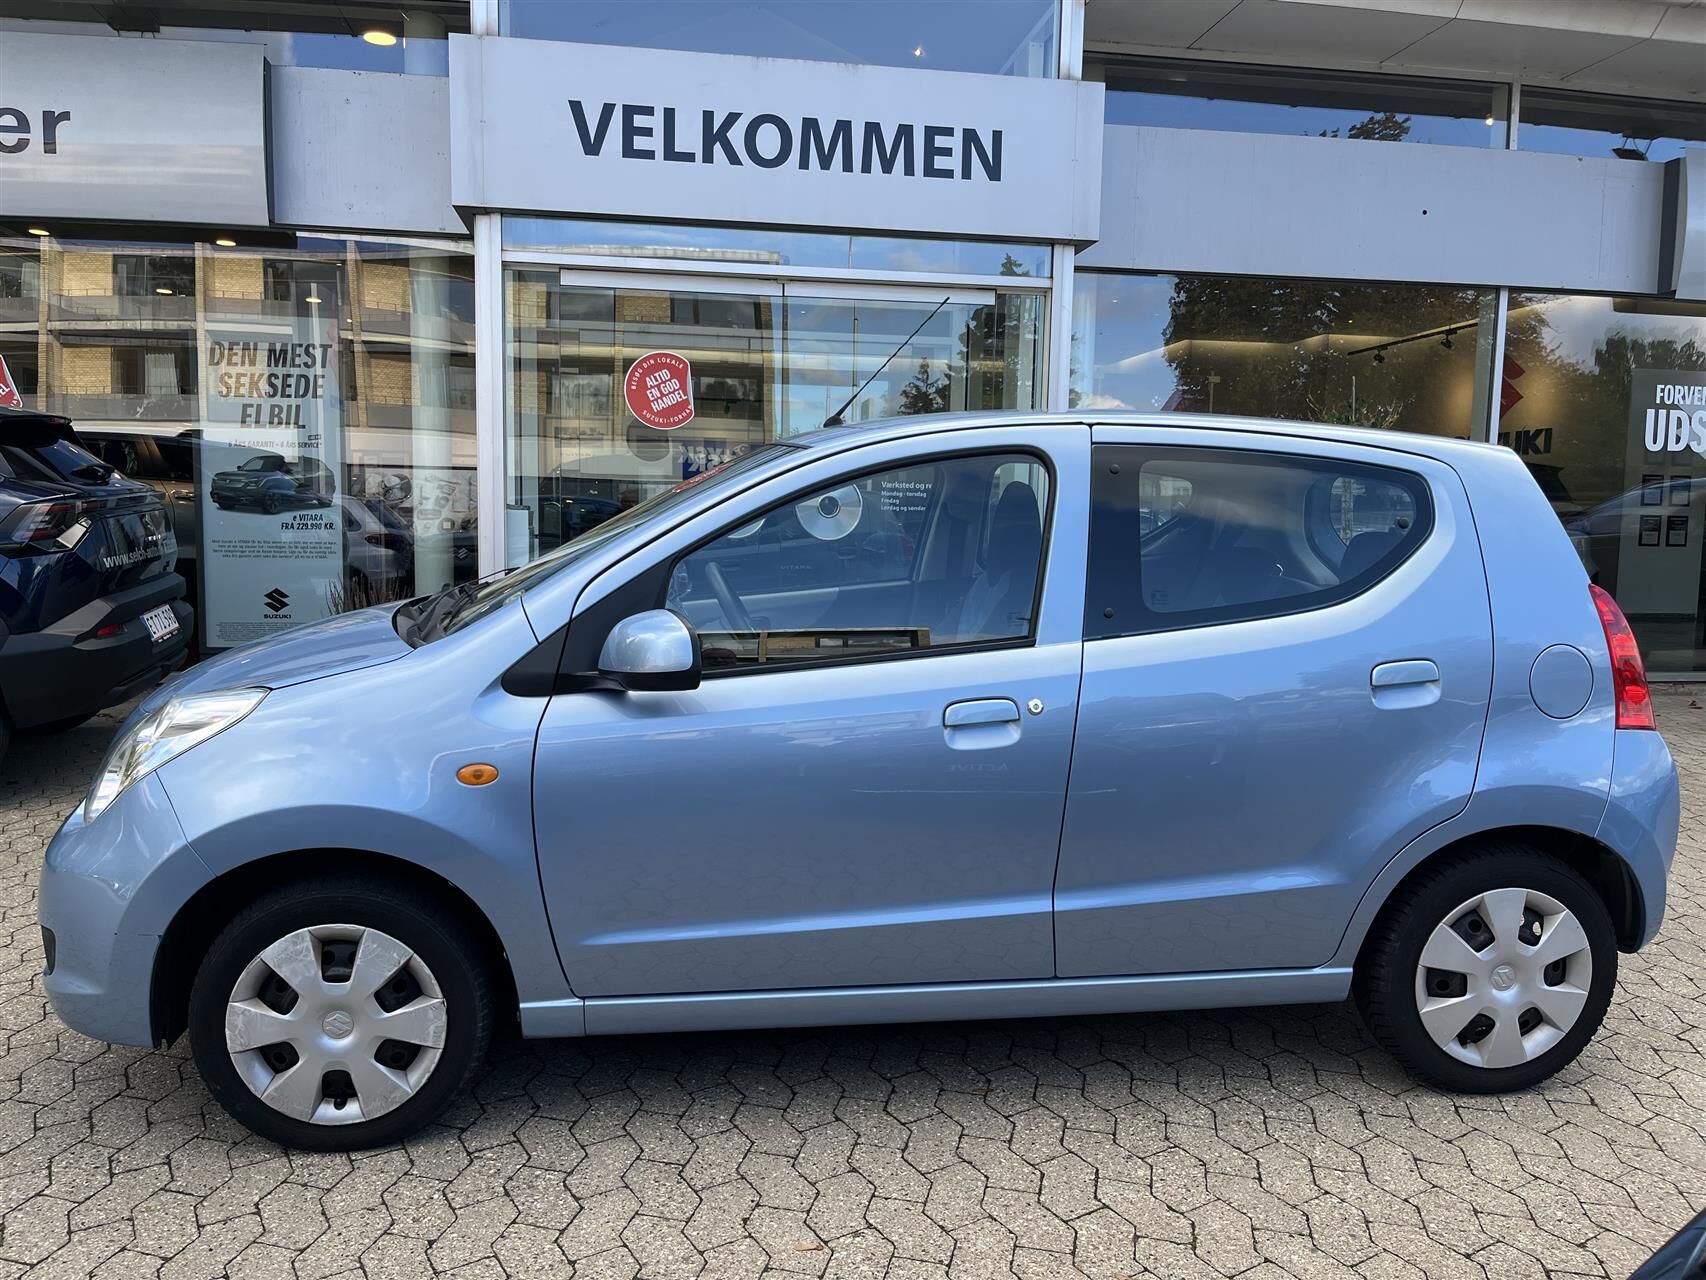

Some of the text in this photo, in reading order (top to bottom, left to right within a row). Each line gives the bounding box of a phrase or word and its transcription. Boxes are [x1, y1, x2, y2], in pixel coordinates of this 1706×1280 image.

[0, 107, 71, 154] er
[568, 99, 1003, 182] VELKOMMEN
[208, 341, 333, 369] DEN MEST
[642, 359, 655, 369] DIN
[657, 356, 685, 369] LOKALE
[217, 371, 326, 399] SEKSEDE
[645, 368, 671, 389] ALTID
[646, 378, 680, 401] EN GOD
[650, 389, 688, 413] HANDEL
[240, 403, 306, 429] ELBIL
[881, 481, 914, 489] Værksted
[915, 482, 925, 490] og
[281, 522, 295, 530] FRA
[298, 513, 324, 522] VITARA
